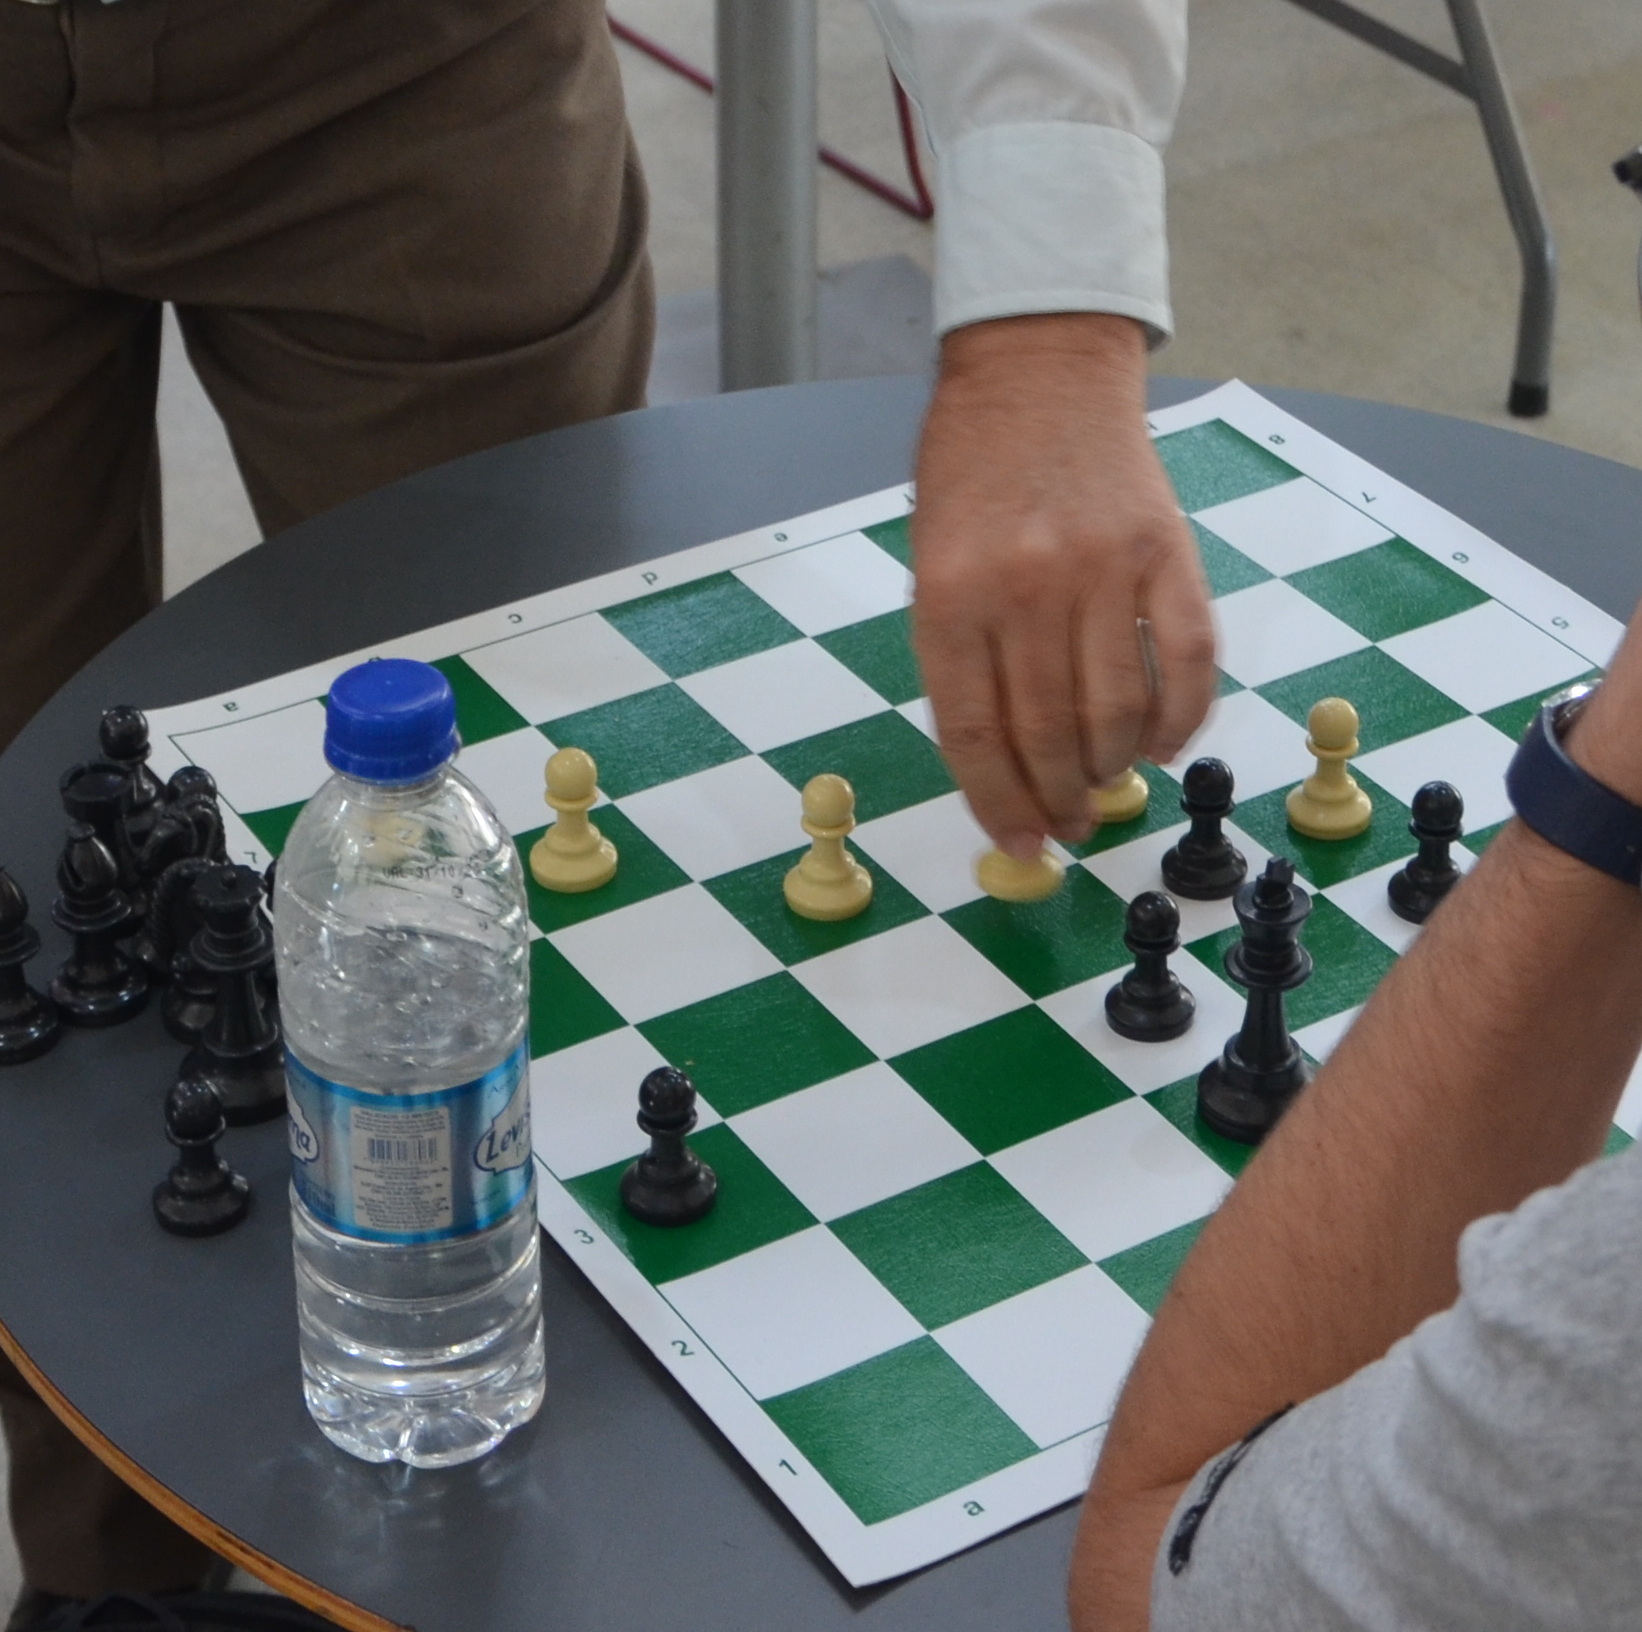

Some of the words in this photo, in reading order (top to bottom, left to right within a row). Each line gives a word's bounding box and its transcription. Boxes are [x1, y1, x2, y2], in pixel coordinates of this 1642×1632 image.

[1268, 434, 1285, 445] 8
[1362, 492, 1376, 504] 7
[774, 532, 788, 543] e
[642, 570, 659, 586] d
[508, 613, 523, 624] c
[1551, 616, 1570, 631] 5
[222, 700, 238, 712] a
[243, 851, 258, 865] 7
[574, 1229, 594, 1245] 3
[671, 1339, 694, 1357] 2
[778, 1458, 798, 1477] 1
[963, 1500, 984, 1517] a
